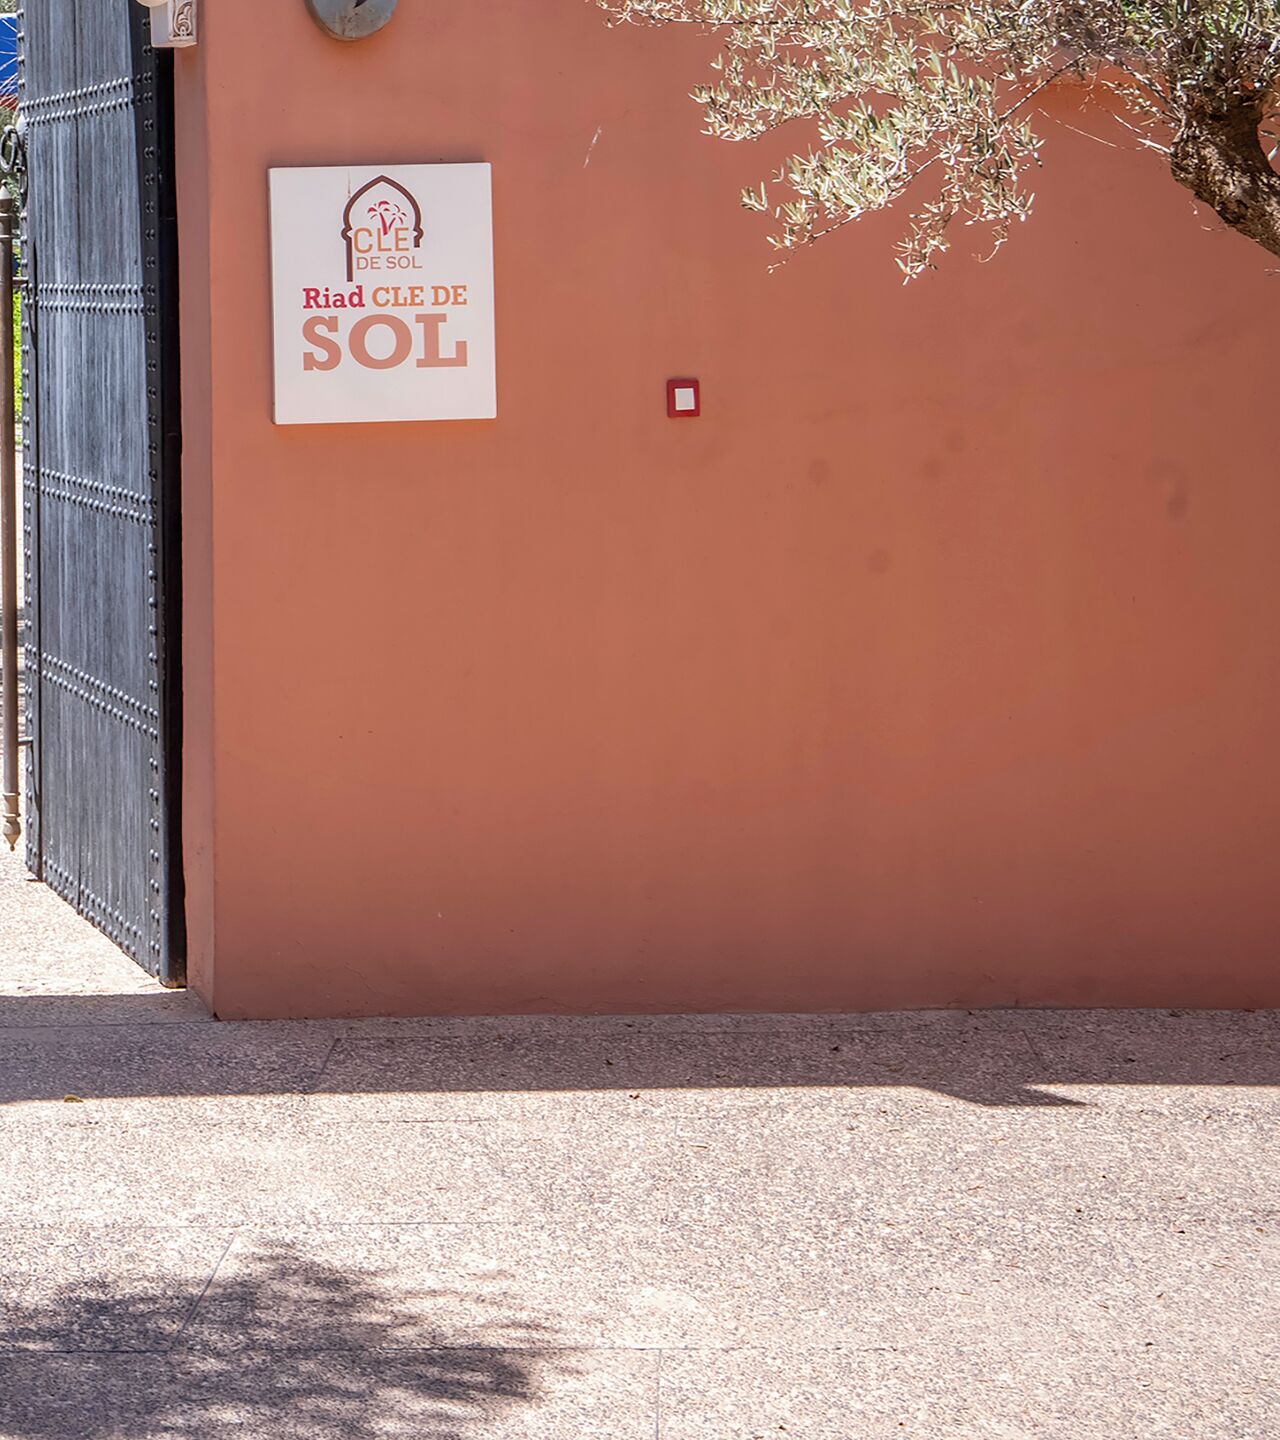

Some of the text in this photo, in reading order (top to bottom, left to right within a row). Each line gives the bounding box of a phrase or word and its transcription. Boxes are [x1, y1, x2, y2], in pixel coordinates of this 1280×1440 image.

[353, 227, 410, 254] CLE
[356, 255, 422, 270] DE SOL
[302, 284, 467, 309] Riad CLE DE
[302, 313, 468, 371] SOL
